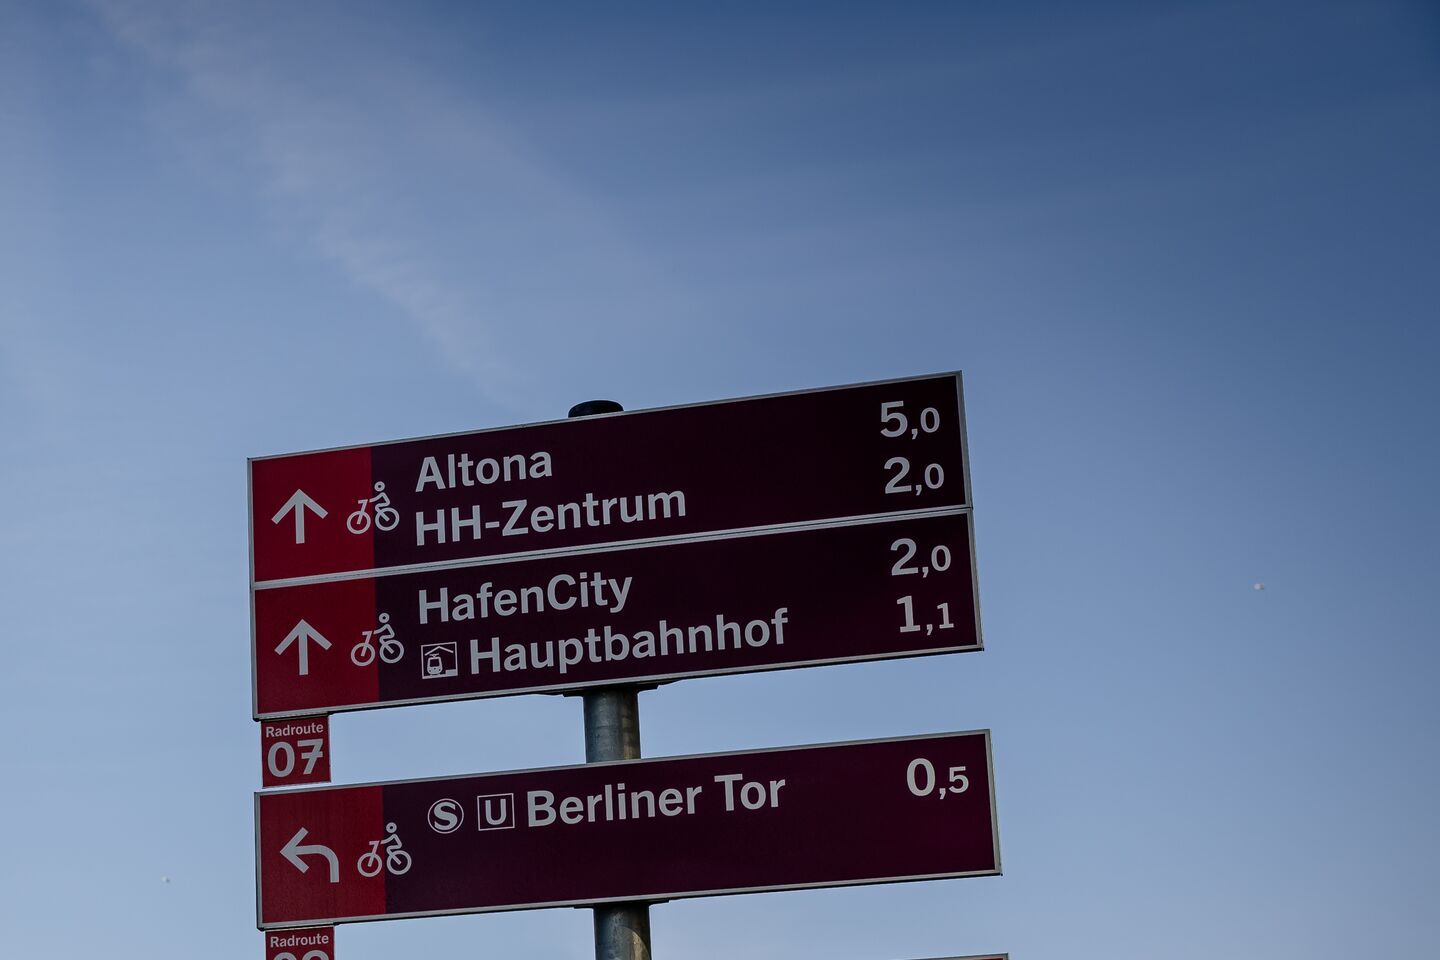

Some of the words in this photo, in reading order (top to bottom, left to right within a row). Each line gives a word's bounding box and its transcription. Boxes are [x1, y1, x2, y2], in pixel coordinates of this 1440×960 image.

[415, 451, 553, 493] Altona
[880, 400, 941, 440] 5,0
[415, 490, 686, 547] HH-Zentrum
[883, 456, 945, 496] 2,0
[418, 571, 633, 625] HafenCity
[890, 537, 952, 579] 2,0
[469, 607, 789, 675] Hauptbahnhof
[896, 595, 955, 636] 1,1
[265, 722, 324, 738] Radroute
[267, 738, 324, 778] 07
[526, 782, 703, 828] Berliner
[713, 773, 786, 812] Tor
[906, 757, 969, 800] 0,5
[270, 933, 329, 948] Radroute
